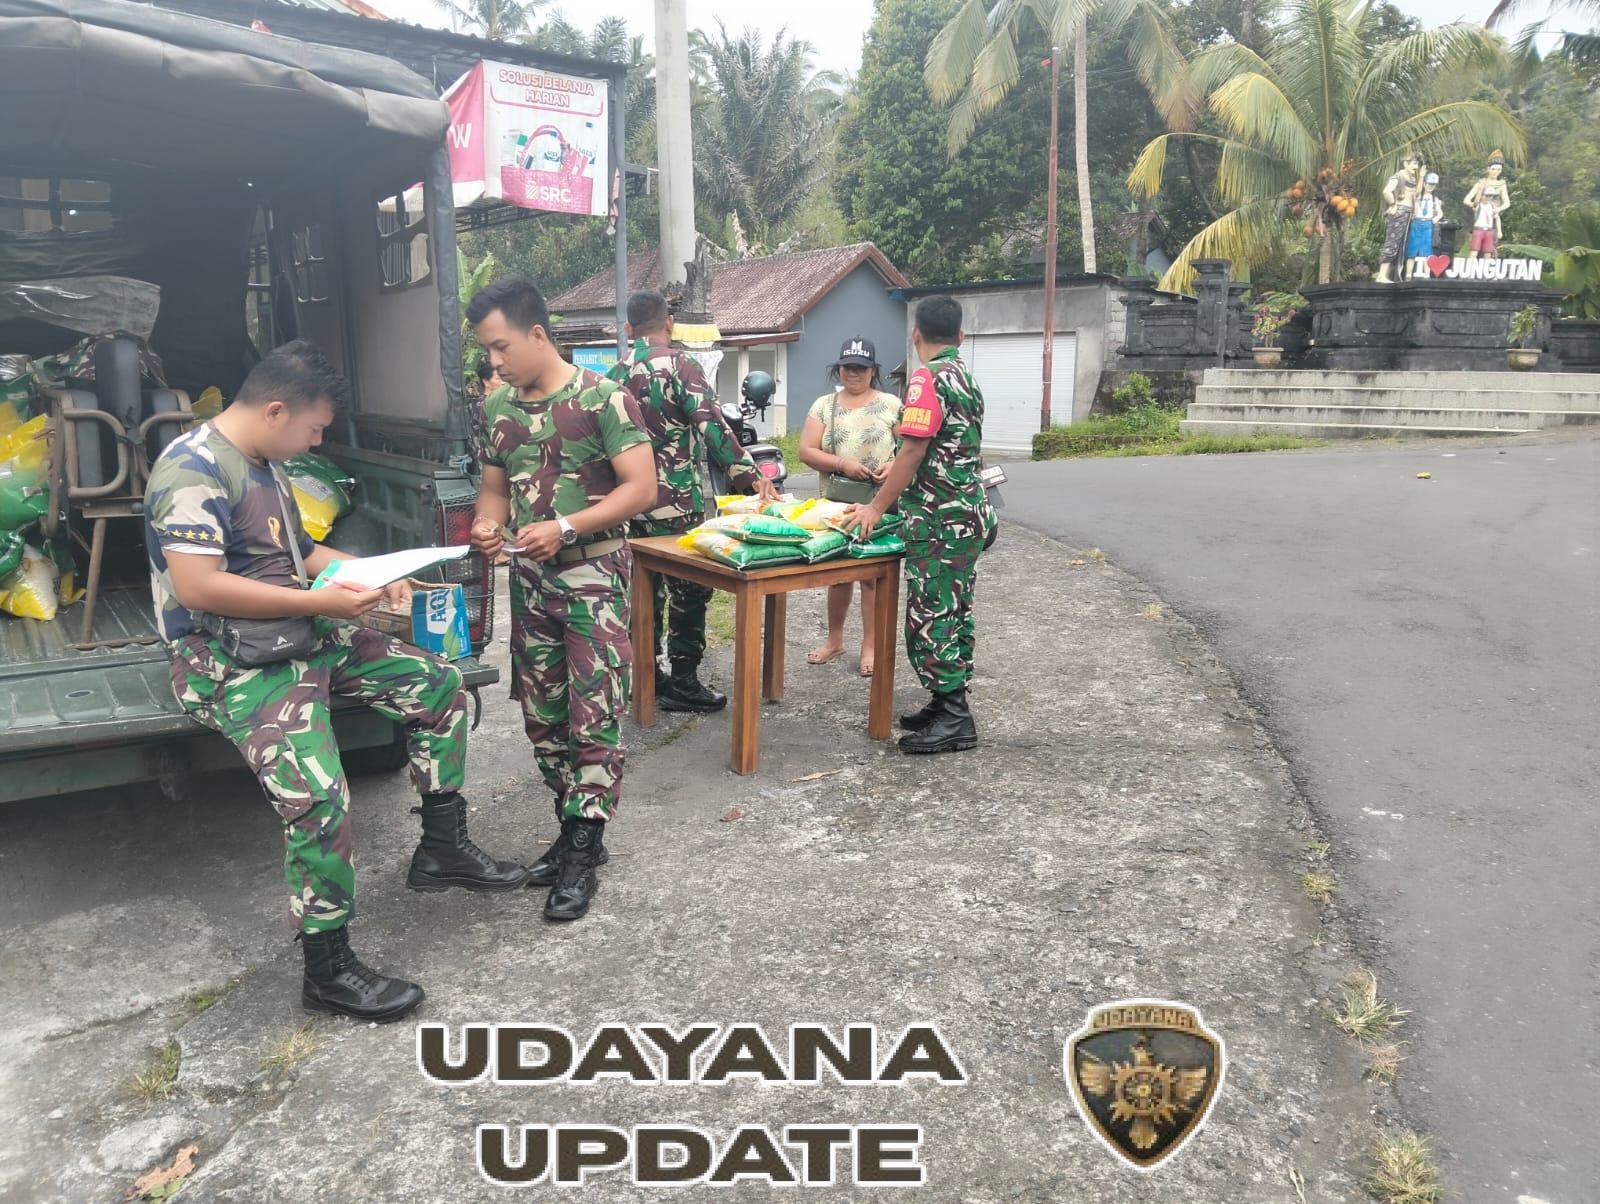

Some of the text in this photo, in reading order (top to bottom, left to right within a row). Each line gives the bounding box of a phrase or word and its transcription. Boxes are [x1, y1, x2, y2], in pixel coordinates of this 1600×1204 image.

[499, 69, 595, 96] SOLUSI BELANJA
[525, 87, 570, 108] HARIAN
[540, 186, 572, 203] SRC
[1445, 257, 1543, 280] JUNGUTAN
[843, 349, 870, 357] ISUZU
